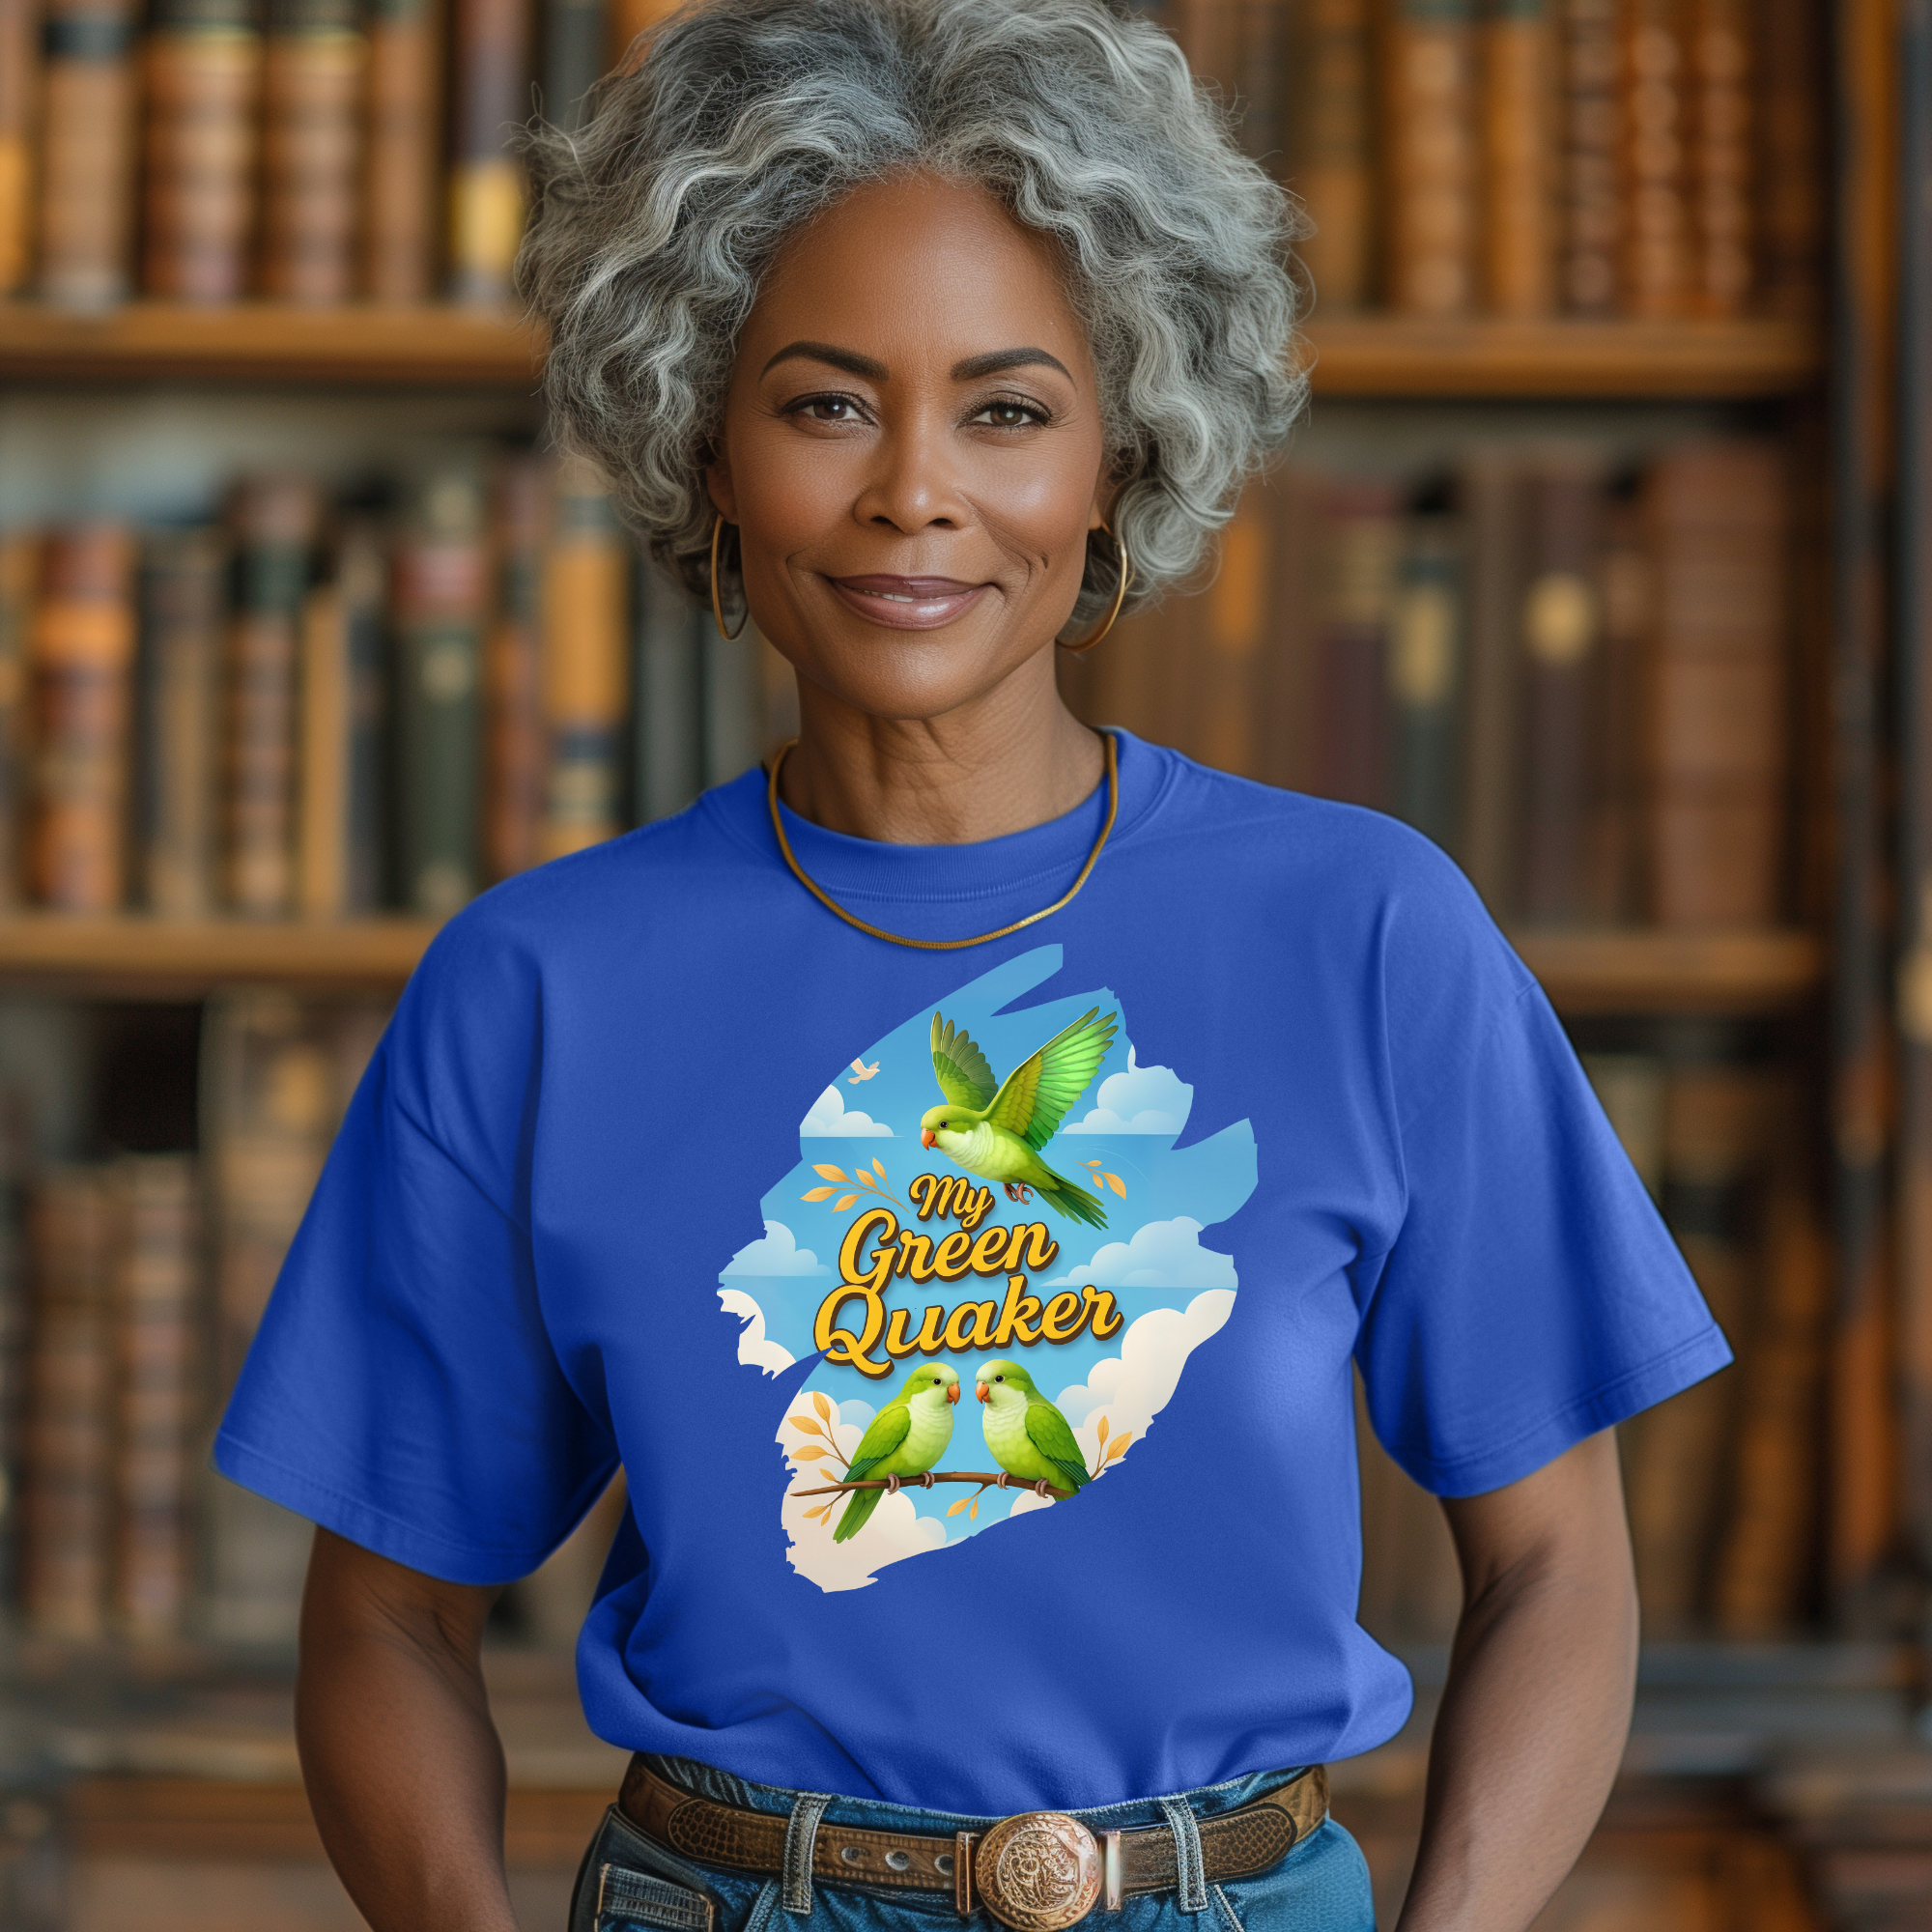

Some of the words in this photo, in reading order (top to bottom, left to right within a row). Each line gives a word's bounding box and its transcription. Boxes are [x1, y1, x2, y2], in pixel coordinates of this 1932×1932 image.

[909, 1173, 995, 1230] My
[838, 1208, 1059, 1293] Green
[813, 1274, 1124, 1380] Quaker
